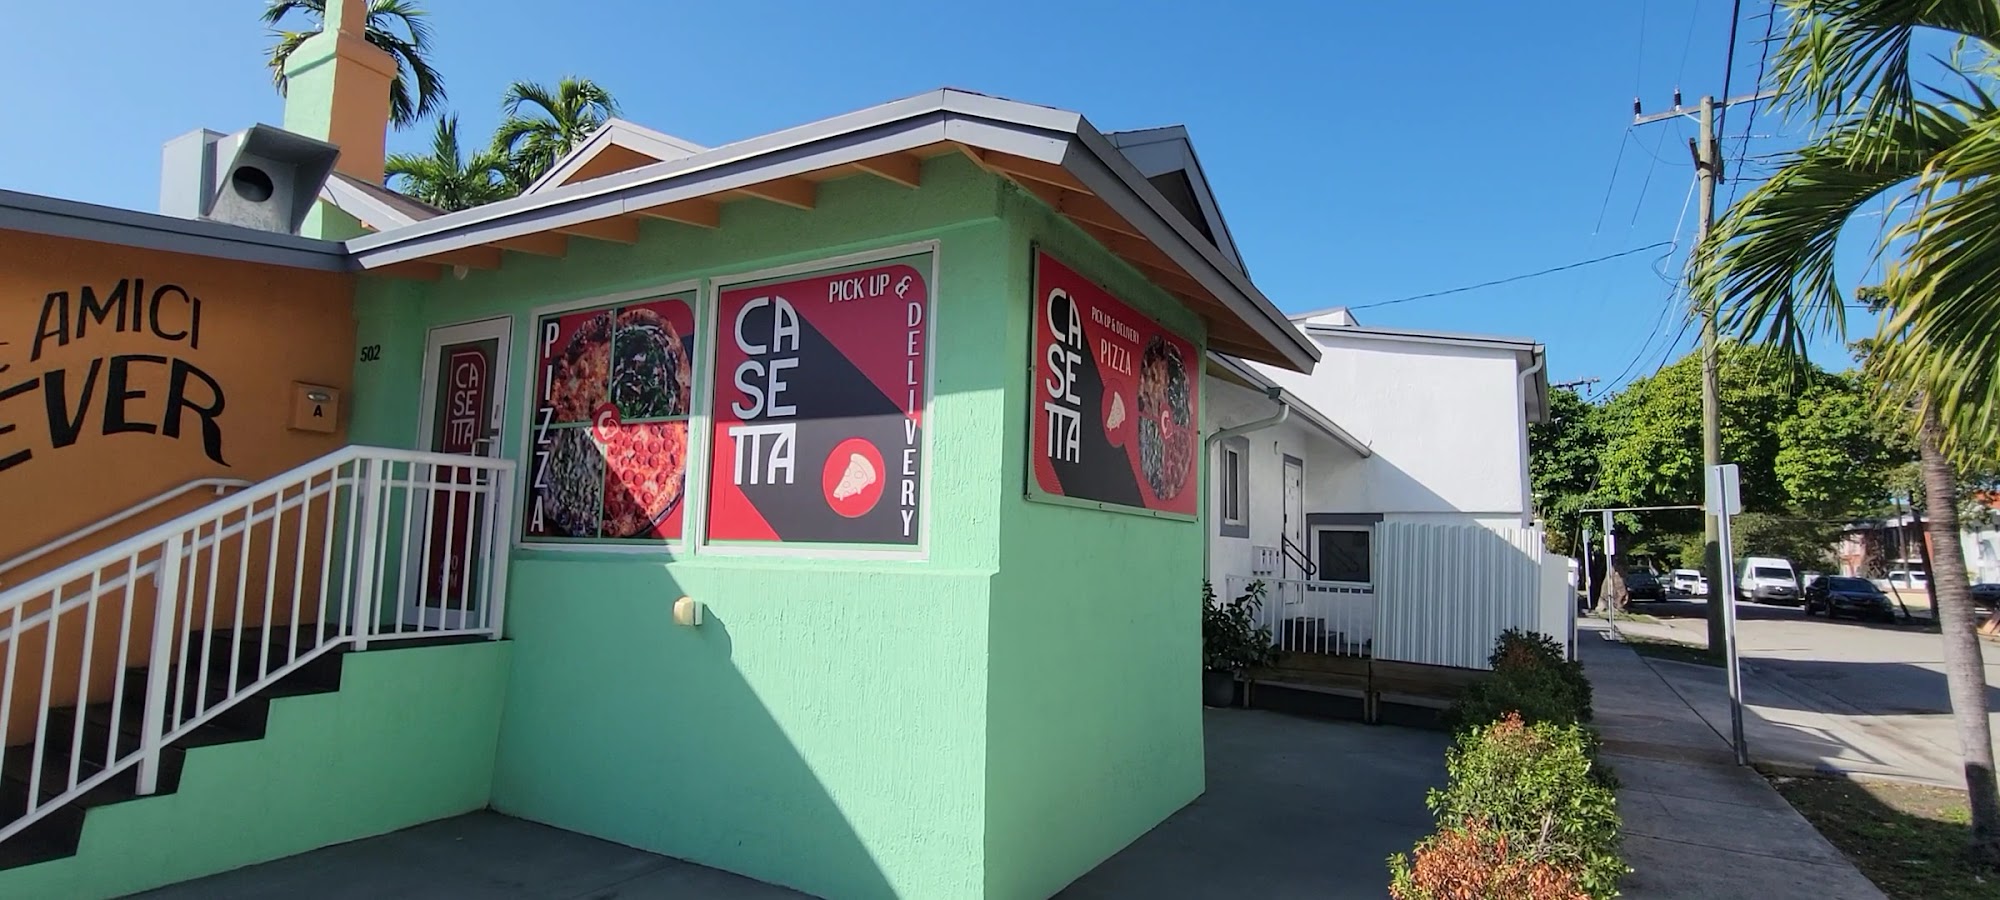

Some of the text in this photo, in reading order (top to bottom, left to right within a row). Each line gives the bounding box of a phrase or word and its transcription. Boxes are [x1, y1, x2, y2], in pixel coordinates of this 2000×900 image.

[828, 273, 913, 303] PICK UP &
[30, 278, 201, 362] AMICI
[734, 295, 800, 355] CA
[1046, 287, 1082, 350] CA
[1091, 306, 1139, 344] PICK UP & DELIVERY
[360, 344, 381, 362] 502
[455, 362, 479, 389] CA
[1046, 343, 1082, 405] SE
[1100, 338, 1131, 376] PIZZA
[313, 404, 323, 418] A
[453, 389, 478, 417] SE
[731, 357, 799, 420] SE
[530, 322, 560, 533] PIZZA
[900, 302, 922, 537] DELIVERY
